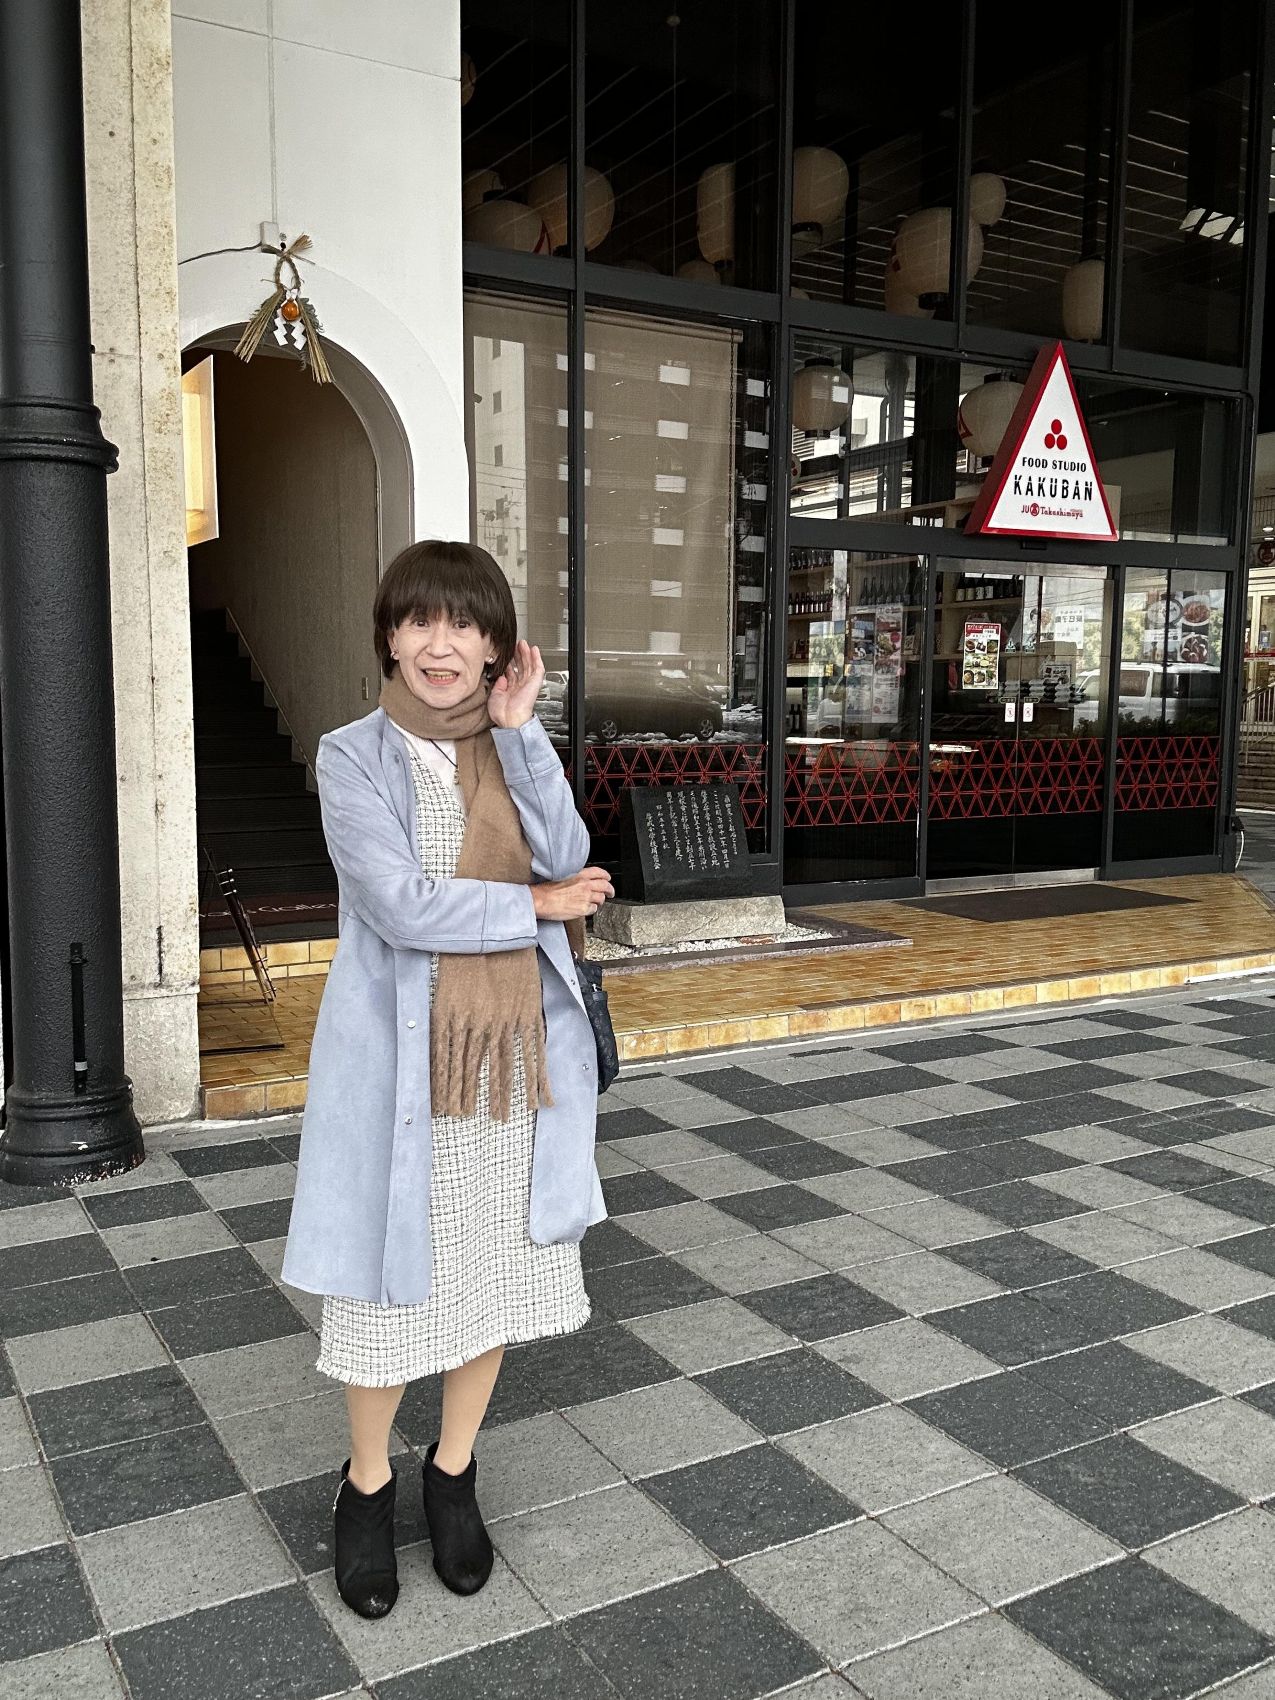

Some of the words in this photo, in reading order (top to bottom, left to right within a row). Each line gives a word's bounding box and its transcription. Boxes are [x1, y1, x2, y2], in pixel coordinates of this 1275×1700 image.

[1022, 457, 1048, 468] FOOD
[1052, 460, 1086, 472] STUDIO
[1014, 475, 1092, 501] KAKUBAN
[1040, 507, 1083, 519] Takashimaya
